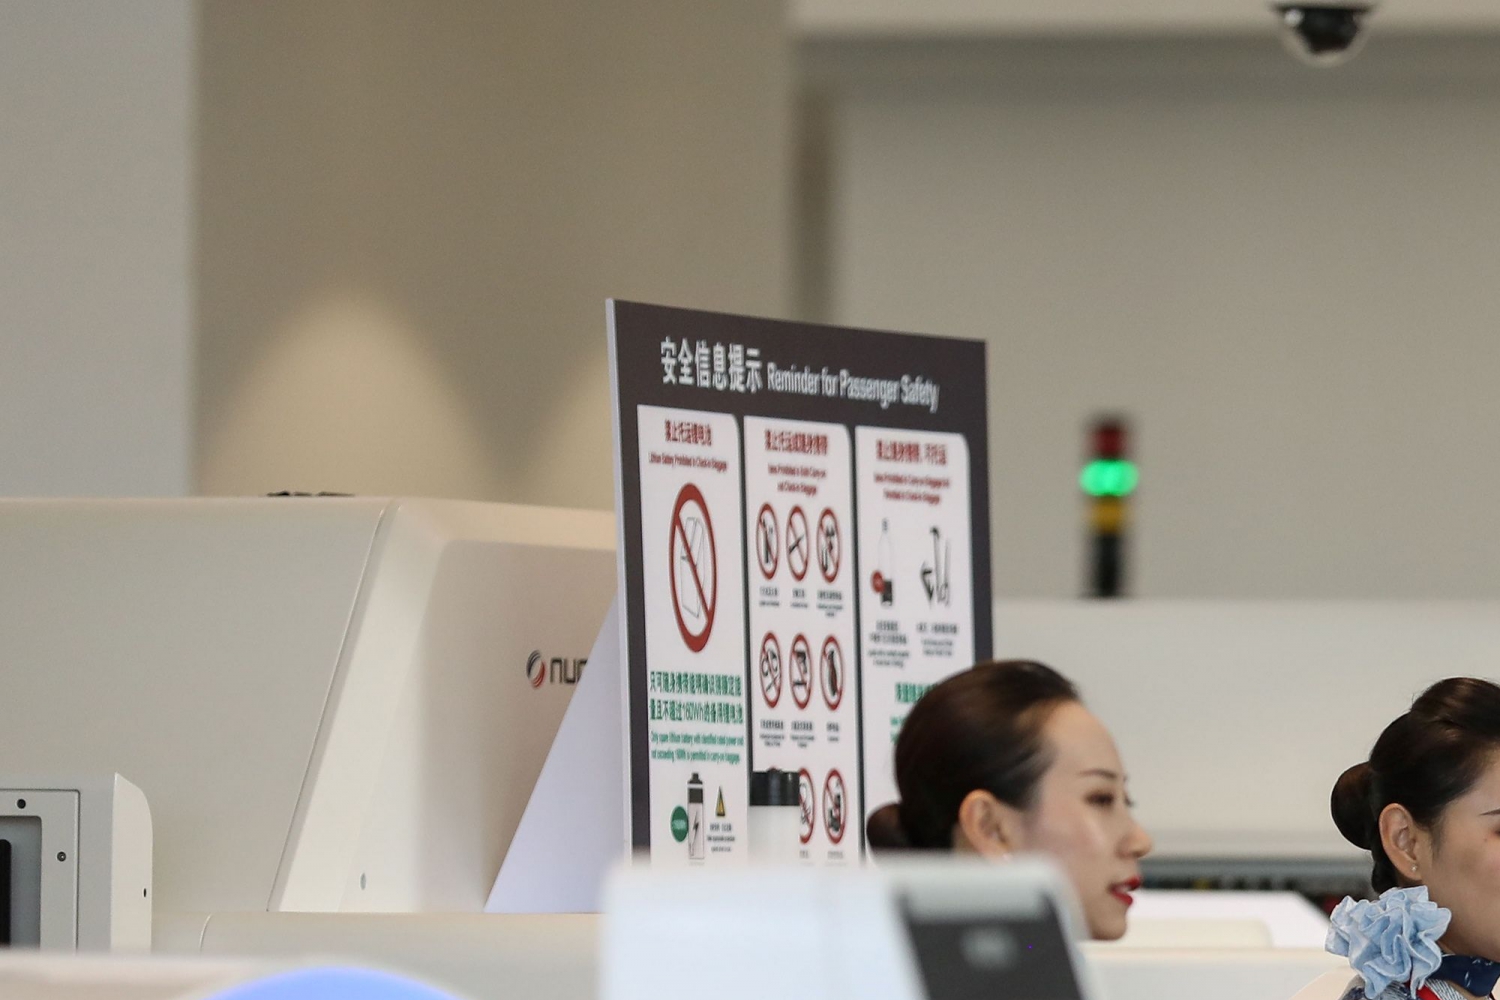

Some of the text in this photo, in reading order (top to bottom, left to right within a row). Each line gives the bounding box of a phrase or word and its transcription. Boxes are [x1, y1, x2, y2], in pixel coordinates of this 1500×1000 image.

[660, 336, 940, 414] 安全信息提示 Reminder for Passenger Safety
